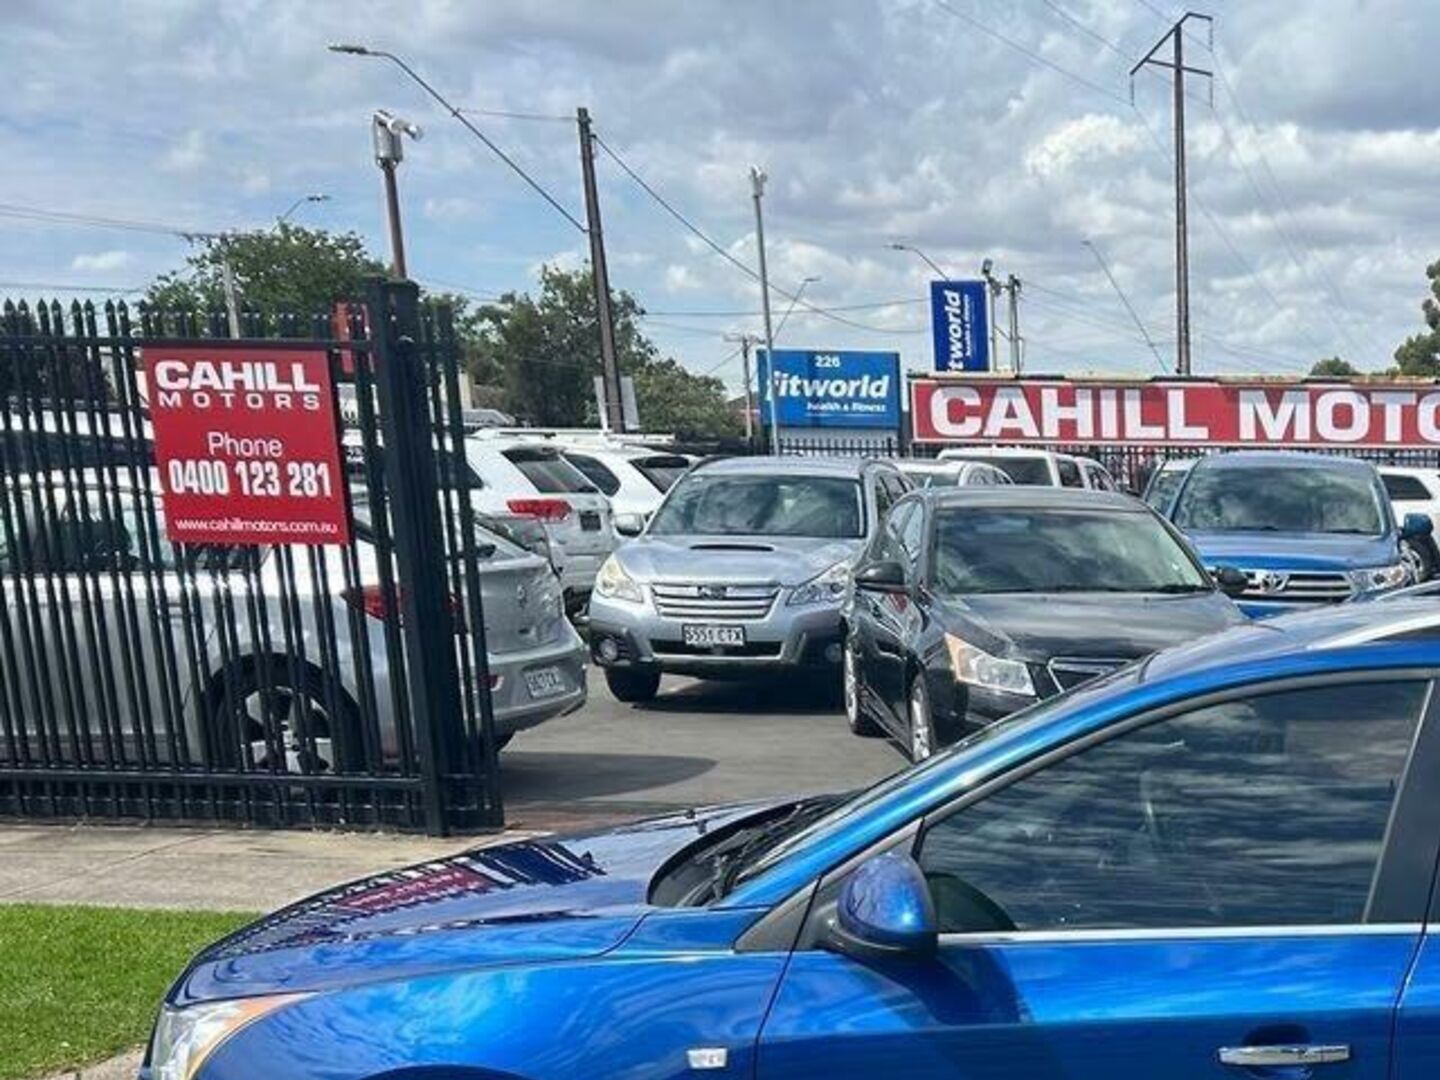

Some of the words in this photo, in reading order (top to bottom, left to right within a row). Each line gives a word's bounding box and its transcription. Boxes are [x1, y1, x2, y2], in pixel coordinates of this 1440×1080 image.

[944, 290, 964, 373] tworld
[814, 355, 841, 368] 226
[154, 360, 320, 392] CAHILL
[157, 391, 320, 410] MOTORS
[930, 387, 1208, 439] CAHILL
[207, 431, 283, 456] Phone
[168, 459, 229, 495] 0400
[235, 460, 281, 496] 123
[287, 462, 332, 497] 281
[175, 517, 338, 533] www.cahillmotors.com.au
